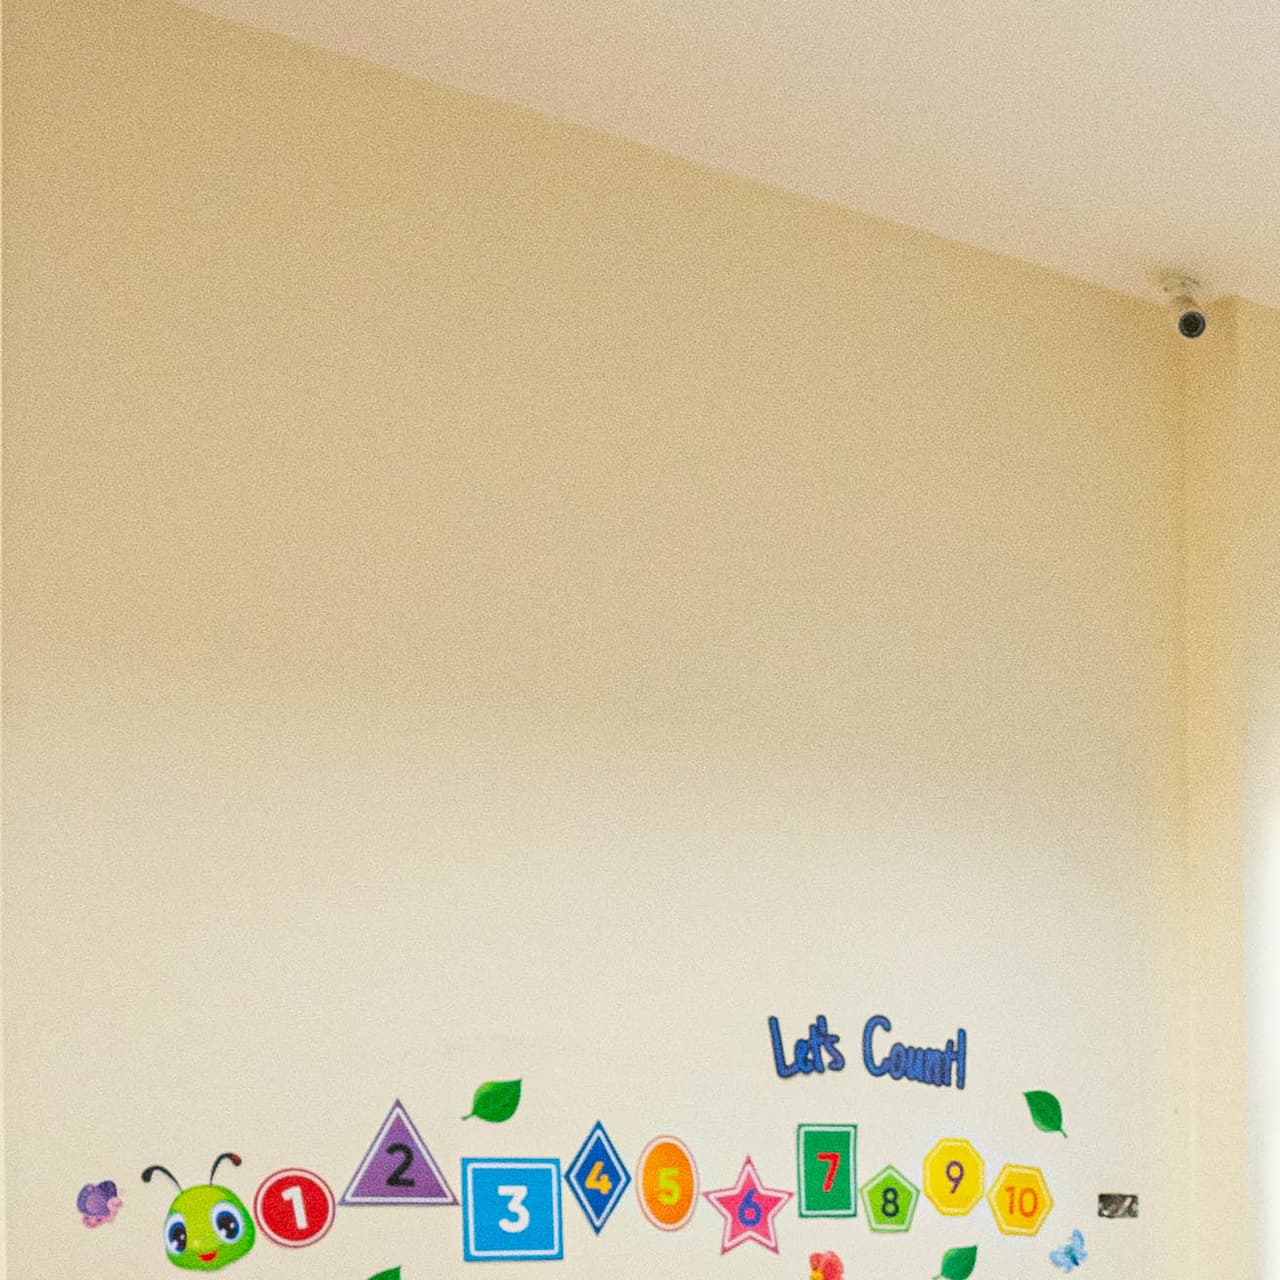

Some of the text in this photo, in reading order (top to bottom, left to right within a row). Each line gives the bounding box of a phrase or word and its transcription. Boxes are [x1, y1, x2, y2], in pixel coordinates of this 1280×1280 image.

[767, 1014, 846, 1079] Let's
[385, 1143, 416, 1188] 2
[585, 1161, 613, 1195] 4
[816, 1152, 841, 1192] 7
[946, 1160, 964, 1194] 9
[658, 1167, 681, 1205] 5
[881, 1187, 900, 1218] 8
[1005, 1185, 1039, 1218] 10
[281, 1185, 308, 1231] 1
[498, 1185, 531, 1233] 3
[737, 1192, 761, 1227] 6
